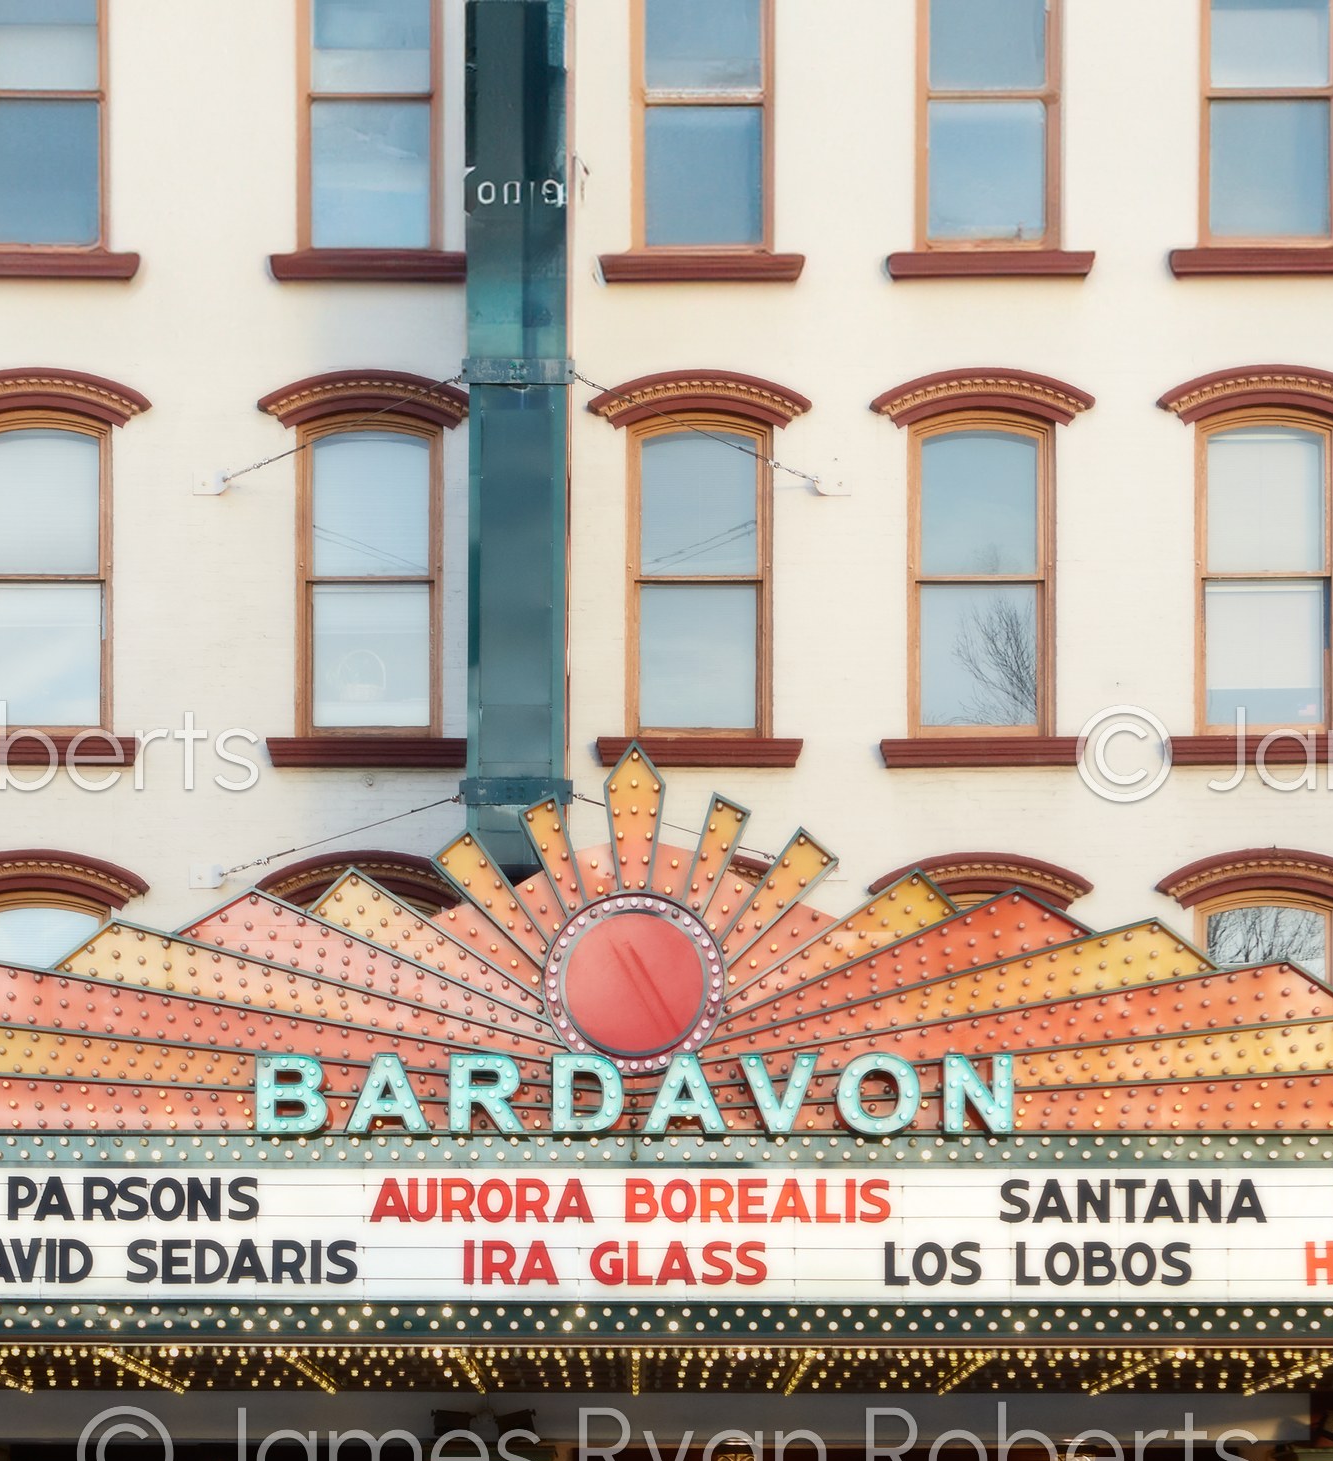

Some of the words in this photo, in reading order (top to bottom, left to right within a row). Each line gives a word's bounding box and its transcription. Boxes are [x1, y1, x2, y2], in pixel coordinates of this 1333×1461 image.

[255, 1052, 1015, 1137] BARDAVON
[7, 1176, 259, 1221] PARSONS
[370, 1177, 593, 1223] AURORA
[624, 1178, 891, 1223] BOREALIS
[999, 1178, 1267, 1224] SANTANA
[126, 1238, 358, 1285] SEDARIS
[463, 1240, 559, 1285] IRA
[589, 1241, 767, 1286] GLASS
[884, 1241, 981, 1286] LOS
[1015, 1241, 1192, 1286] LOBOS
